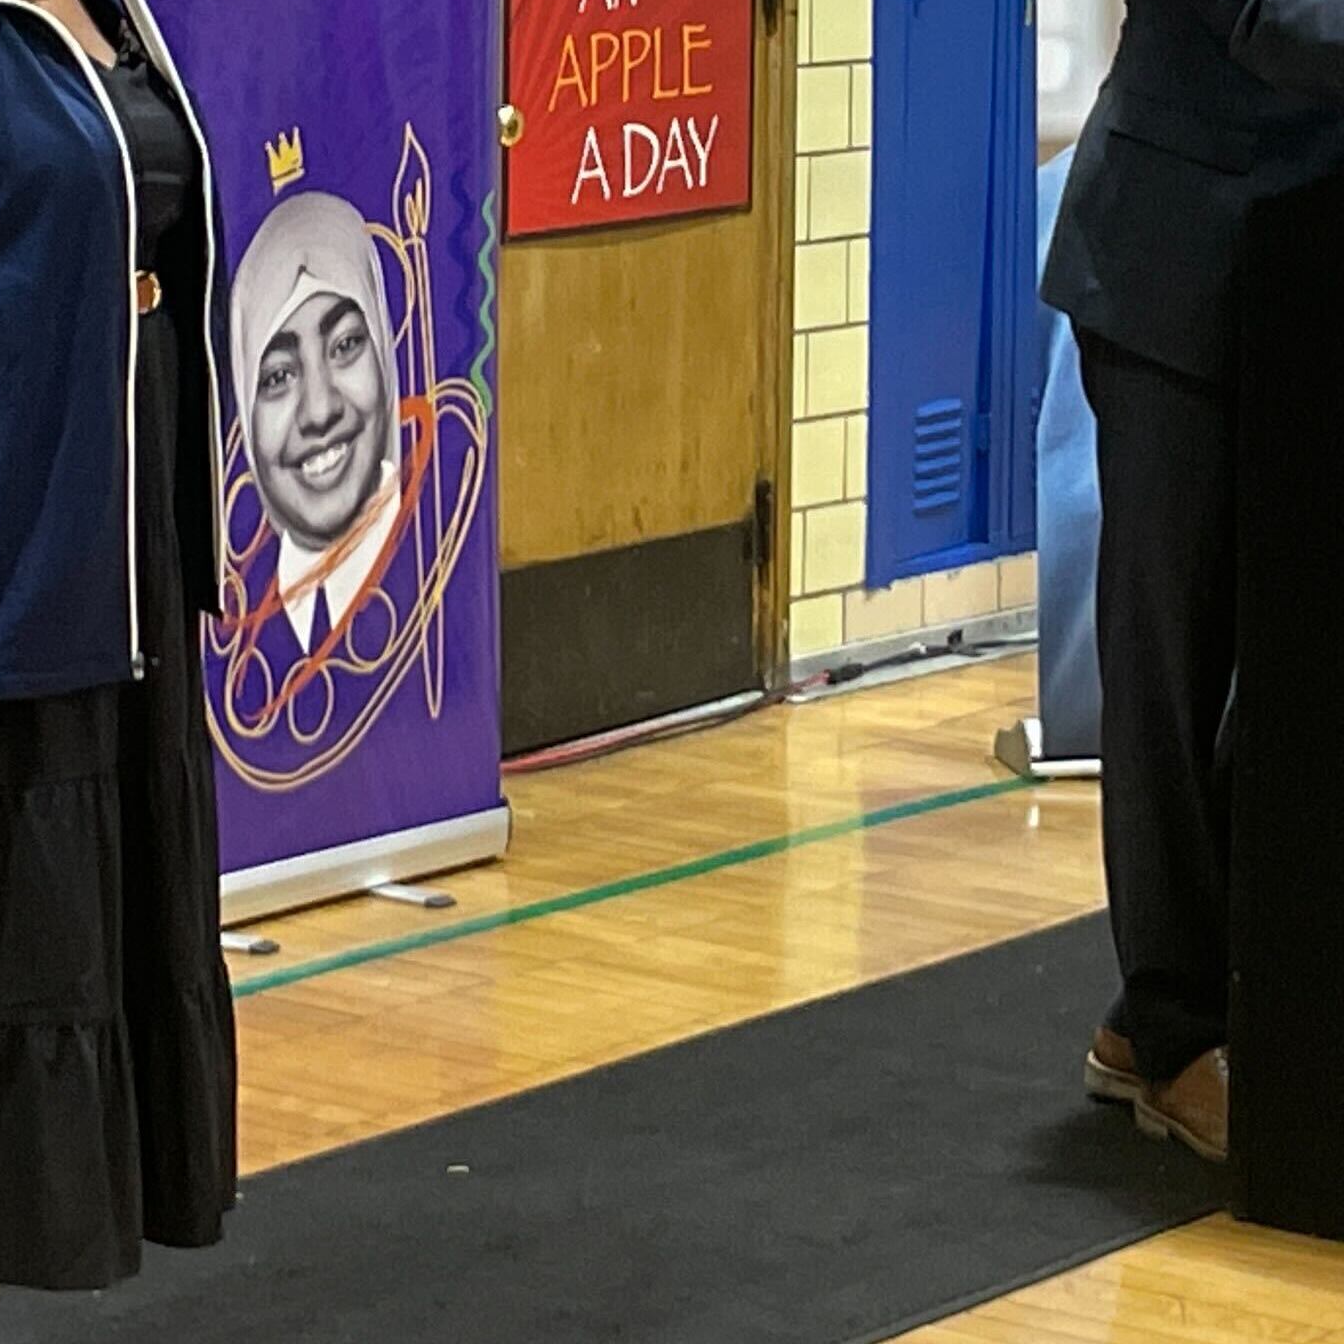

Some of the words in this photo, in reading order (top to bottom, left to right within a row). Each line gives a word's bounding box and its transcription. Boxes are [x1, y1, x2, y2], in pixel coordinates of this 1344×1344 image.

[548, 23, 712, 112] APPLE
[571, 126, 611, 205] A
[622, 114, 719, 198] DAY
